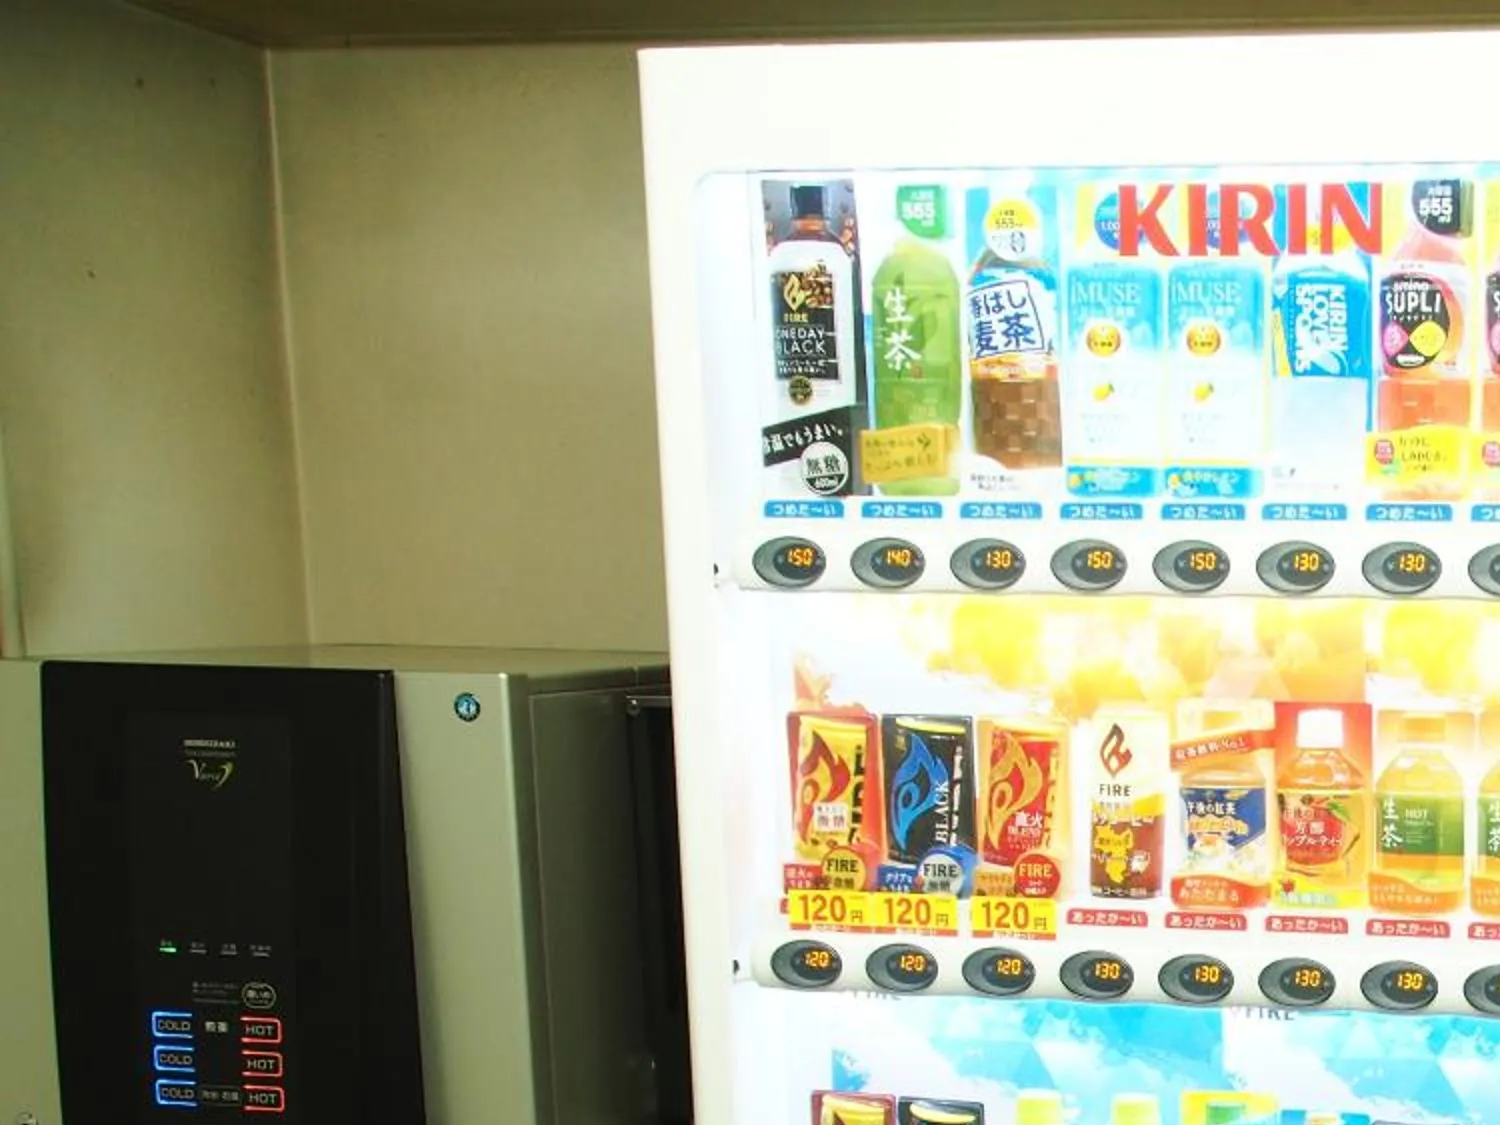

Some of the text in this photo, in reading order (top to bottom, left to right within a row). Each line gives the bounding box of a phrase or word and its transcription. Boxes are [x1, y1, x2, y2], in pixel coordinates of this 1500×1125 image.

[1118, 182, 1382, 256] KIRIN
[1386, 292, 1441, 313] SUPLI
[885, 286, 922, 369] 生茶
[787, 549, 813, 566] 150
[886, 549, 911, 566] 140
[986, 551, 1011, 568] 130
[1087, 551, 1113, 568] 150
[1190, 552, 1216, 569] 150
[1294, 554, 1319, 571] 130
[1399, 555, 1425, 572] 130
[1099, 784, 1132, 796] FIRE
[935, 780, 949, 842] BLACK
[1381, 797, 1404, 849] 生茶
[825, 858, 858, 872] FIRE
[923, 864, 958, 878] FIRE
[1019, 863, 1053, 877] FIRE
[805, 951, 829, 967] 120
[900, 955, 925, 972] 120
[996, 958, 1021, 975] 120
[1094, 963, 1120, 979] 130
[1195, 966, 1220, 983] 130
[1295, 970, 1321, 987] 130
[1398, 973, 1424, 990] 130
[158, 1020, 191, 1032] COLD
[246, 1024, 275, 1036] HOT
[160, 1054, 193, 1066] COLD
[247, 1059, 275, 1070] HOT
[161, 1087, 195, 1099] COLD
[250, 1093, 278, 1105] HOT
